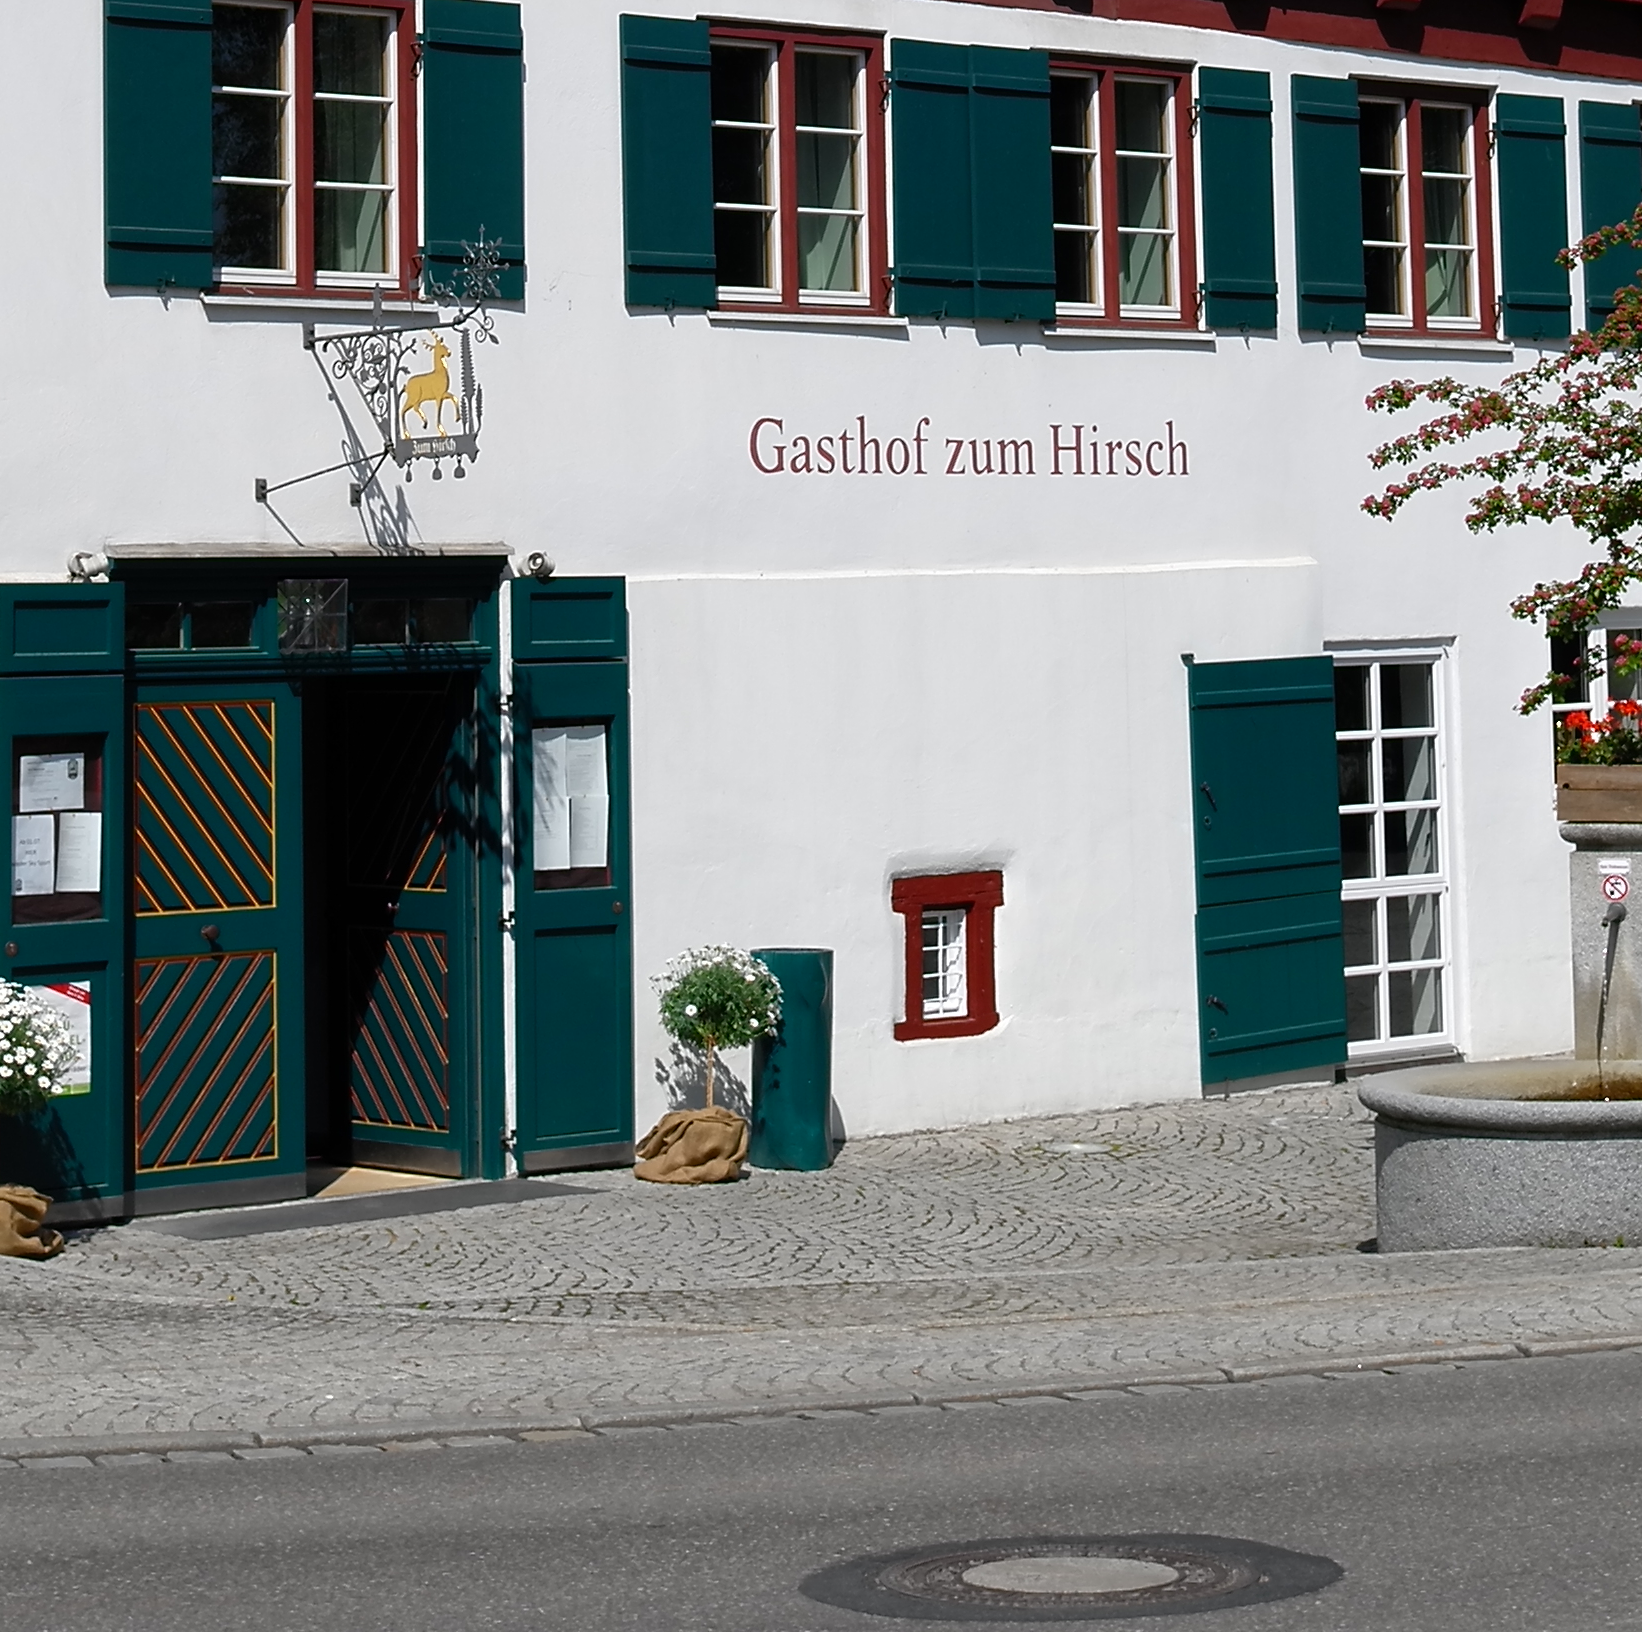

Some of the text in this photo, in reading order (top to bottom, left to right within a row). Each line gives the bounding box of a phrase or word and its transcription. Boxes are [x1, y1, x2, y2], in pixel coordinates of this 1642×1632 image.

[748, 415, 1190, 477] Gasthof zum Hirsch
